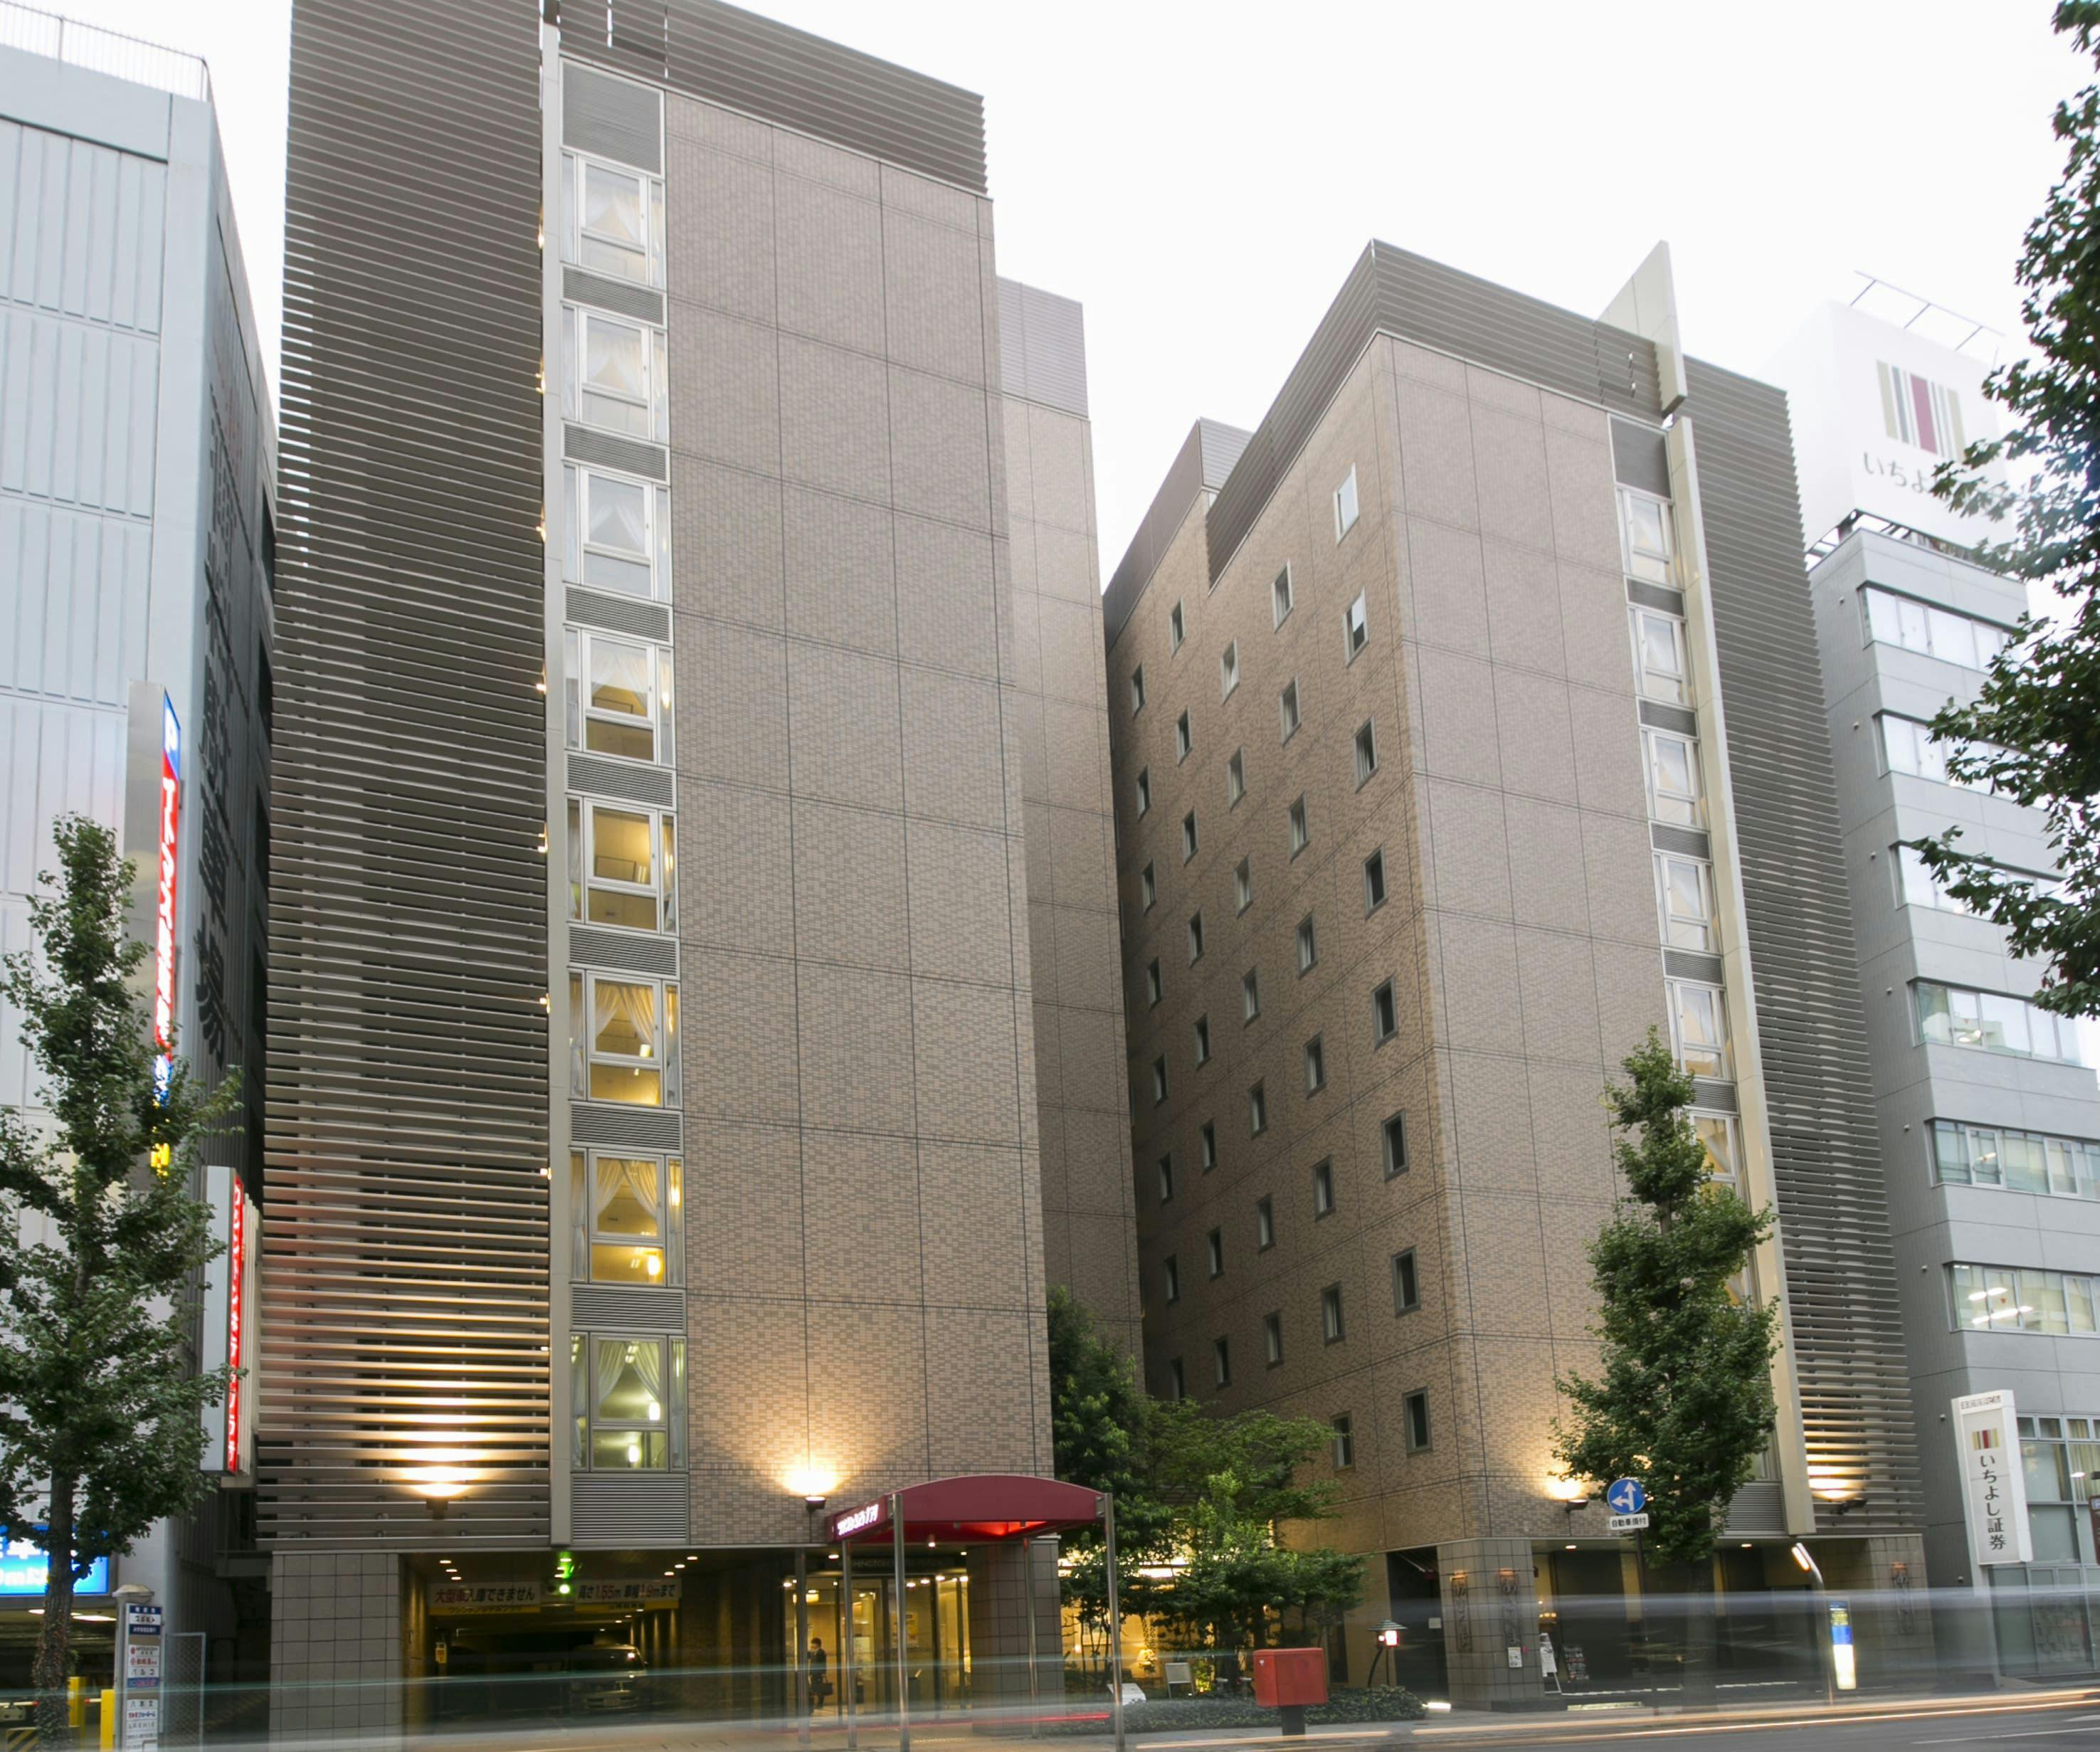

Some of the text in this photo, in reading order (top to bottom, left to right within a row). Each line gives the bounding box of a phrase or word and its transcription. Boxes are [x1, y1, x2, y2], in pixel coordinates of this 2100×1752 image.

[1864, 452, 1934, 493] いちよ
[165, 707, 178, 753] P
[1980, 1455, 2007, 1551] いちよし証券
[434, 1586, 536, 1603] 大型車入庫できません
